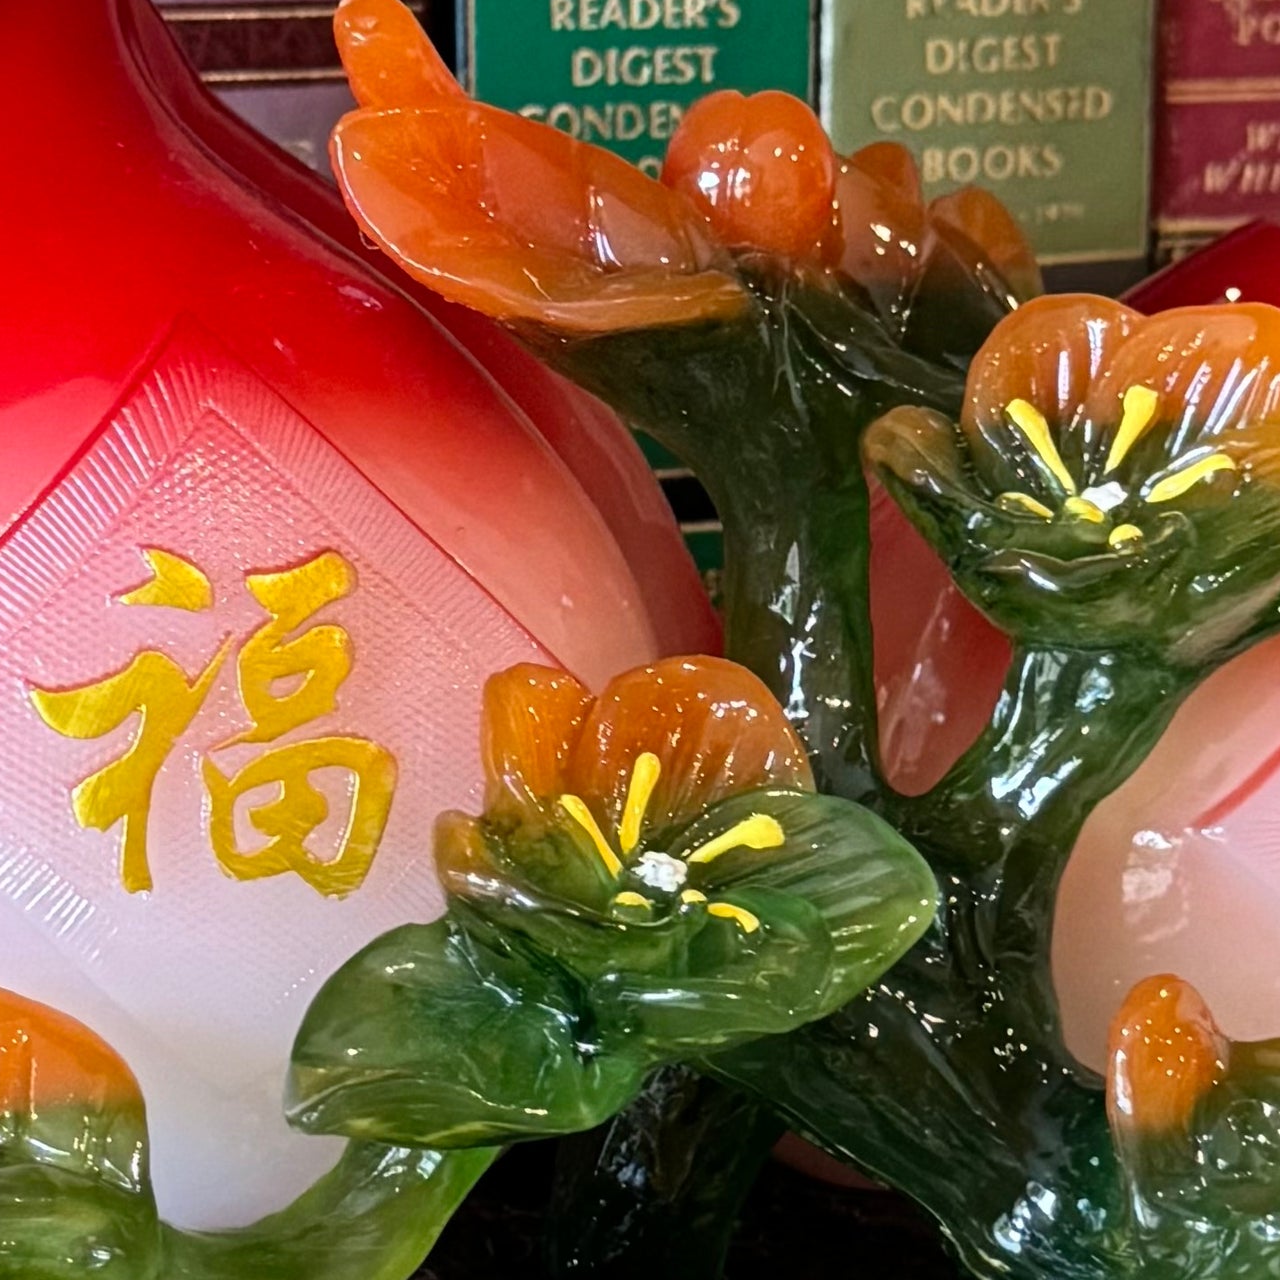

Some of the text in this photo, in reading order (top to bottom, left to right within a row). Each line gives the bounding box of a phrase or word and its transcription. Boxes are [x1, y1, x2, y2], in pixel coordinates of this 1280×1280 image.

[571, 46, 718, 87] DIGEST
[925, 33, 1063, 75] DIGEST
[871, 87, 1113, 132] CONDENSED
[923, 144, 1064, 183] BOOKS
[28, 546, 397, 899] 福
